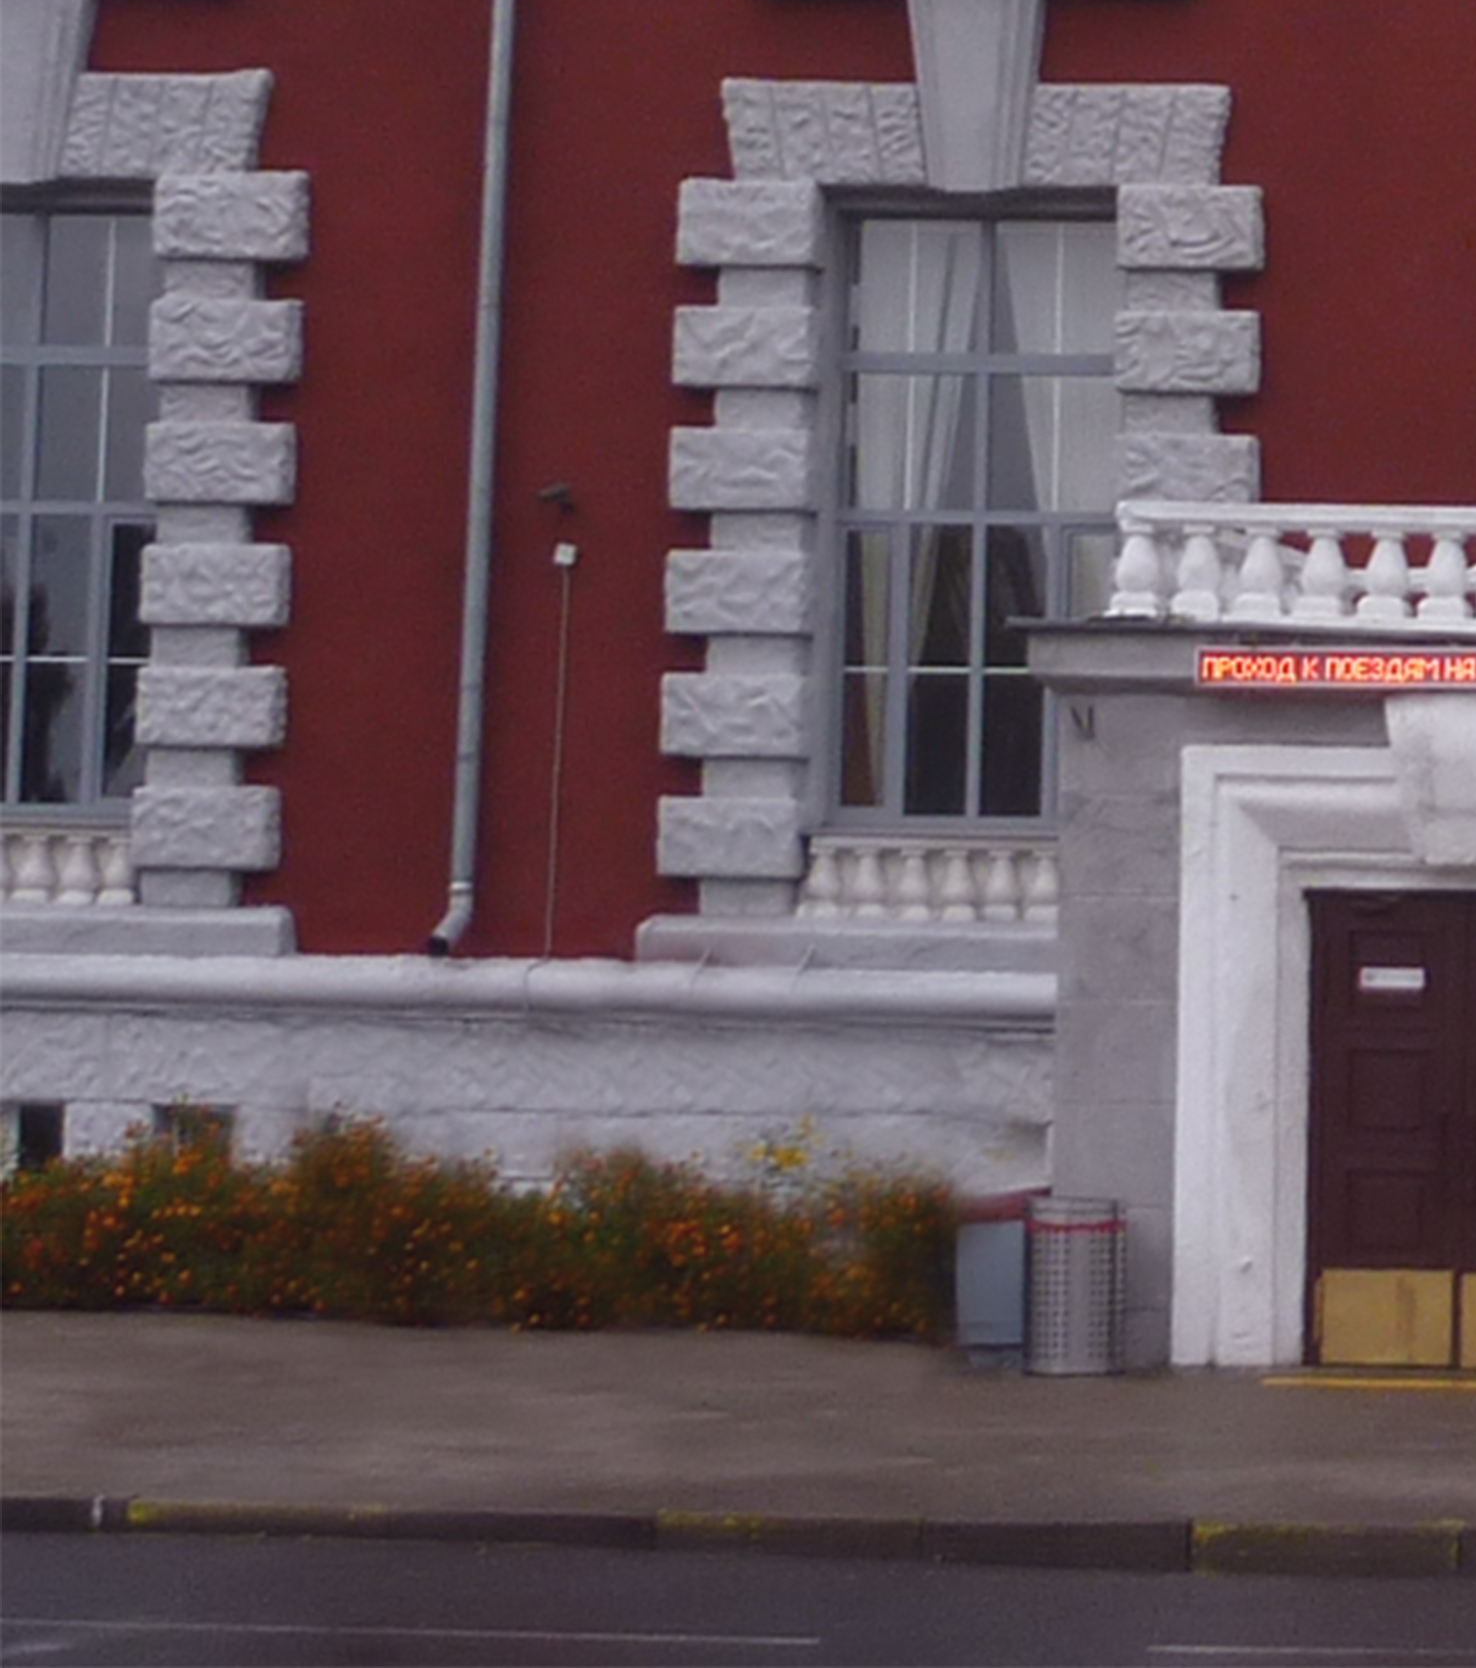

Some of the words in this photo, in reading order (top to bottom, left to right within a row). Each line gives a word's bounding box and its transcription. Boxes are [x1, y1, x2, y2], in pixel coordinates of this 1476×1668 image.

[1202, 657, 1296, 681] ПРОХОД
[1303, 657, 1319, 679] К
[1325, 656, 1440, 681] ПОЕЗДАМ
[1444, 657, 1476, 680] НА
